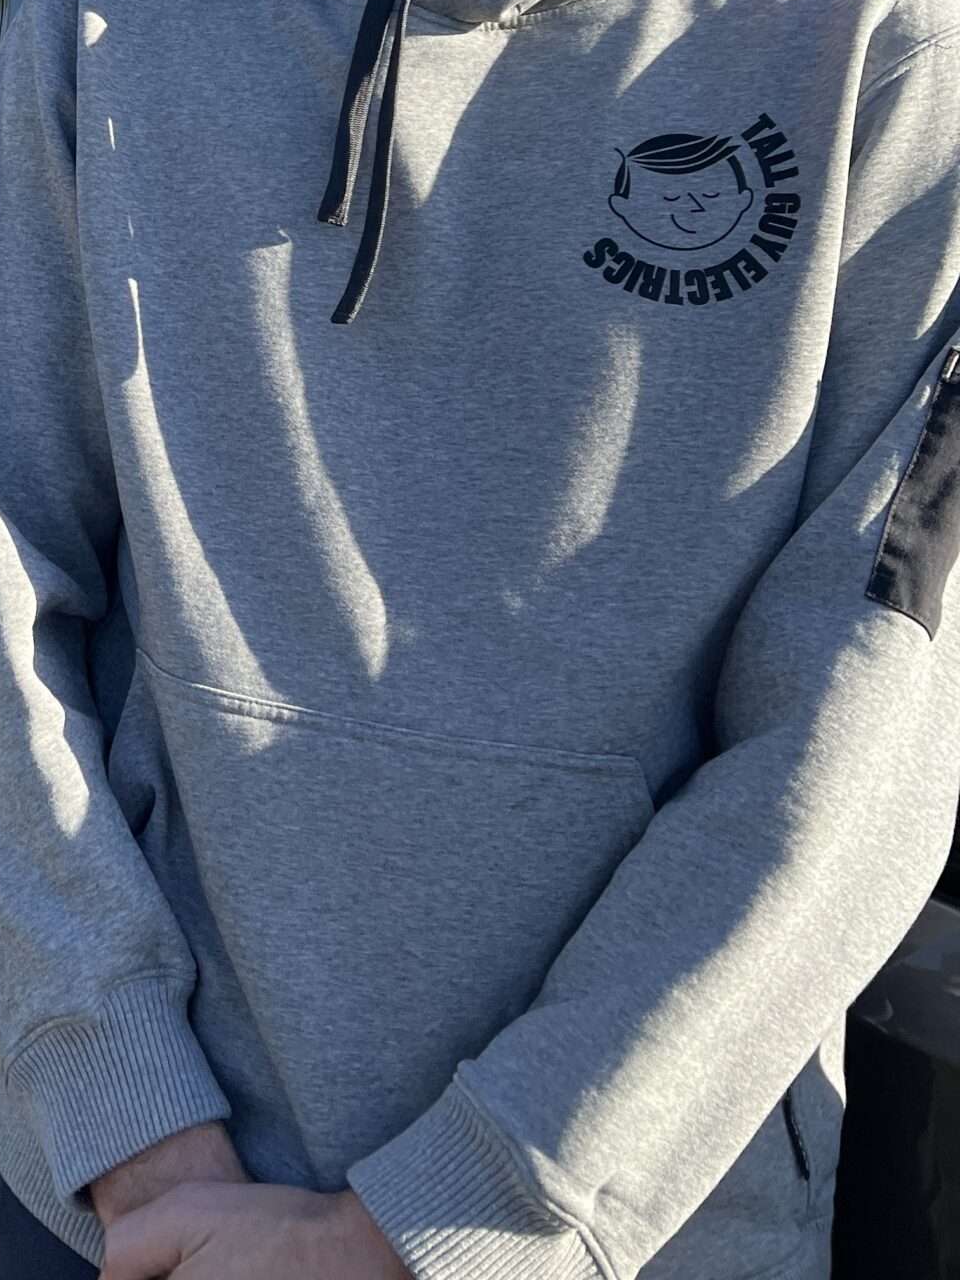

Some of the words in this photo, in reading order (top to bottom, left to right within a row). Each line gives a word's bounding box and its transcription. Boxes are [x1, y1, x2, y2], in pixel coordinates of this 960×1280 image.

[741, 112, 800, 188] TALL
[749, 192, 801, 263] GUY
[583, 237, 769, 306] ELECTRICS
